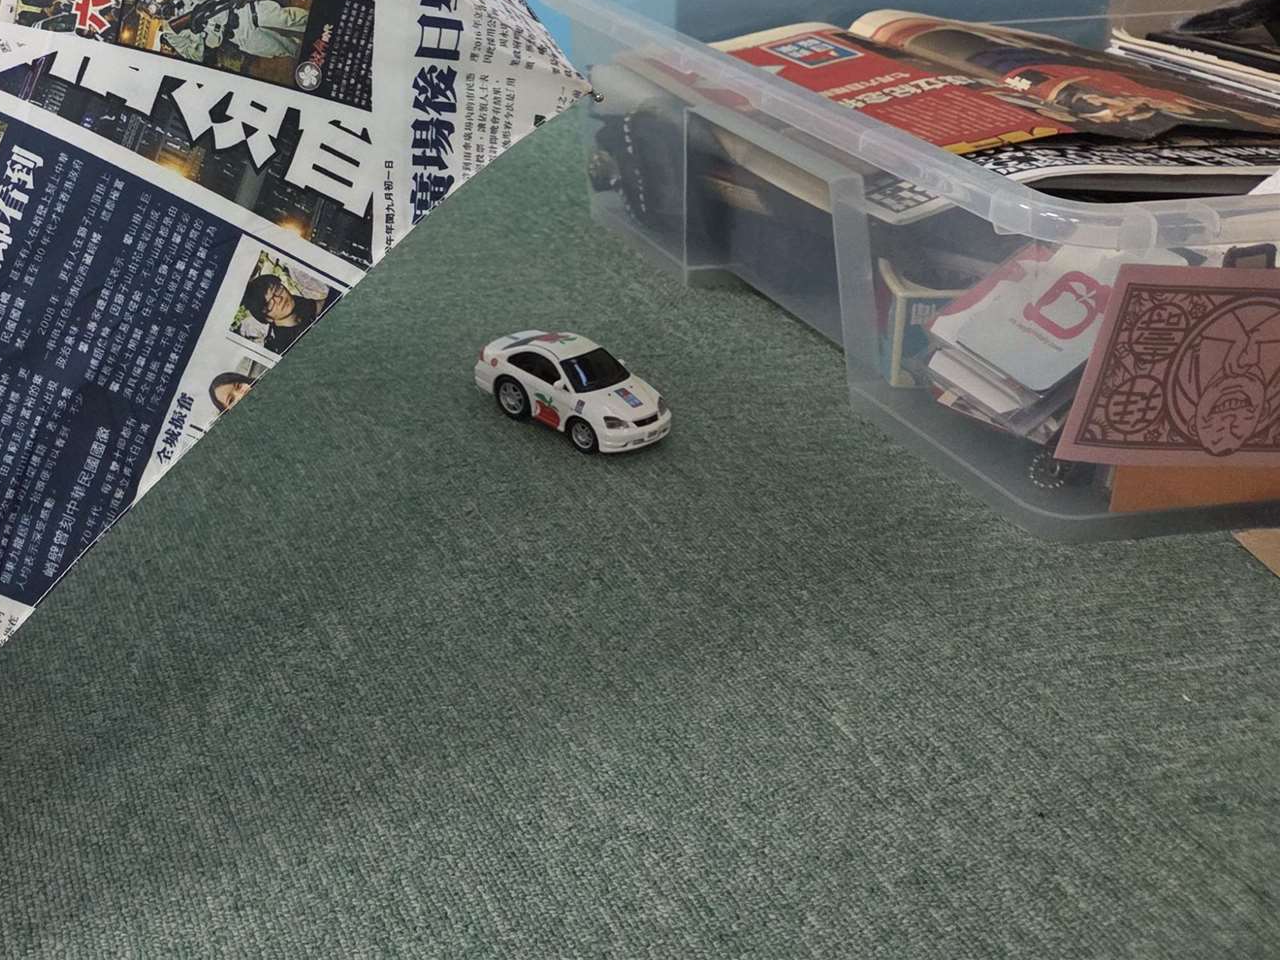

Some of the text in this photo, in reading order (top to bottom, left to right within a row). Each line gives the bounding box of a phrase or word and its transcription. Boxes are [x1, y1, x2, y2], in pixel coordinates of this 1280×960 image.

[153, 390, 196, 467] 全城振奮
[39, 423, 114, 579] 峭壁曾刻中華民國國徽
